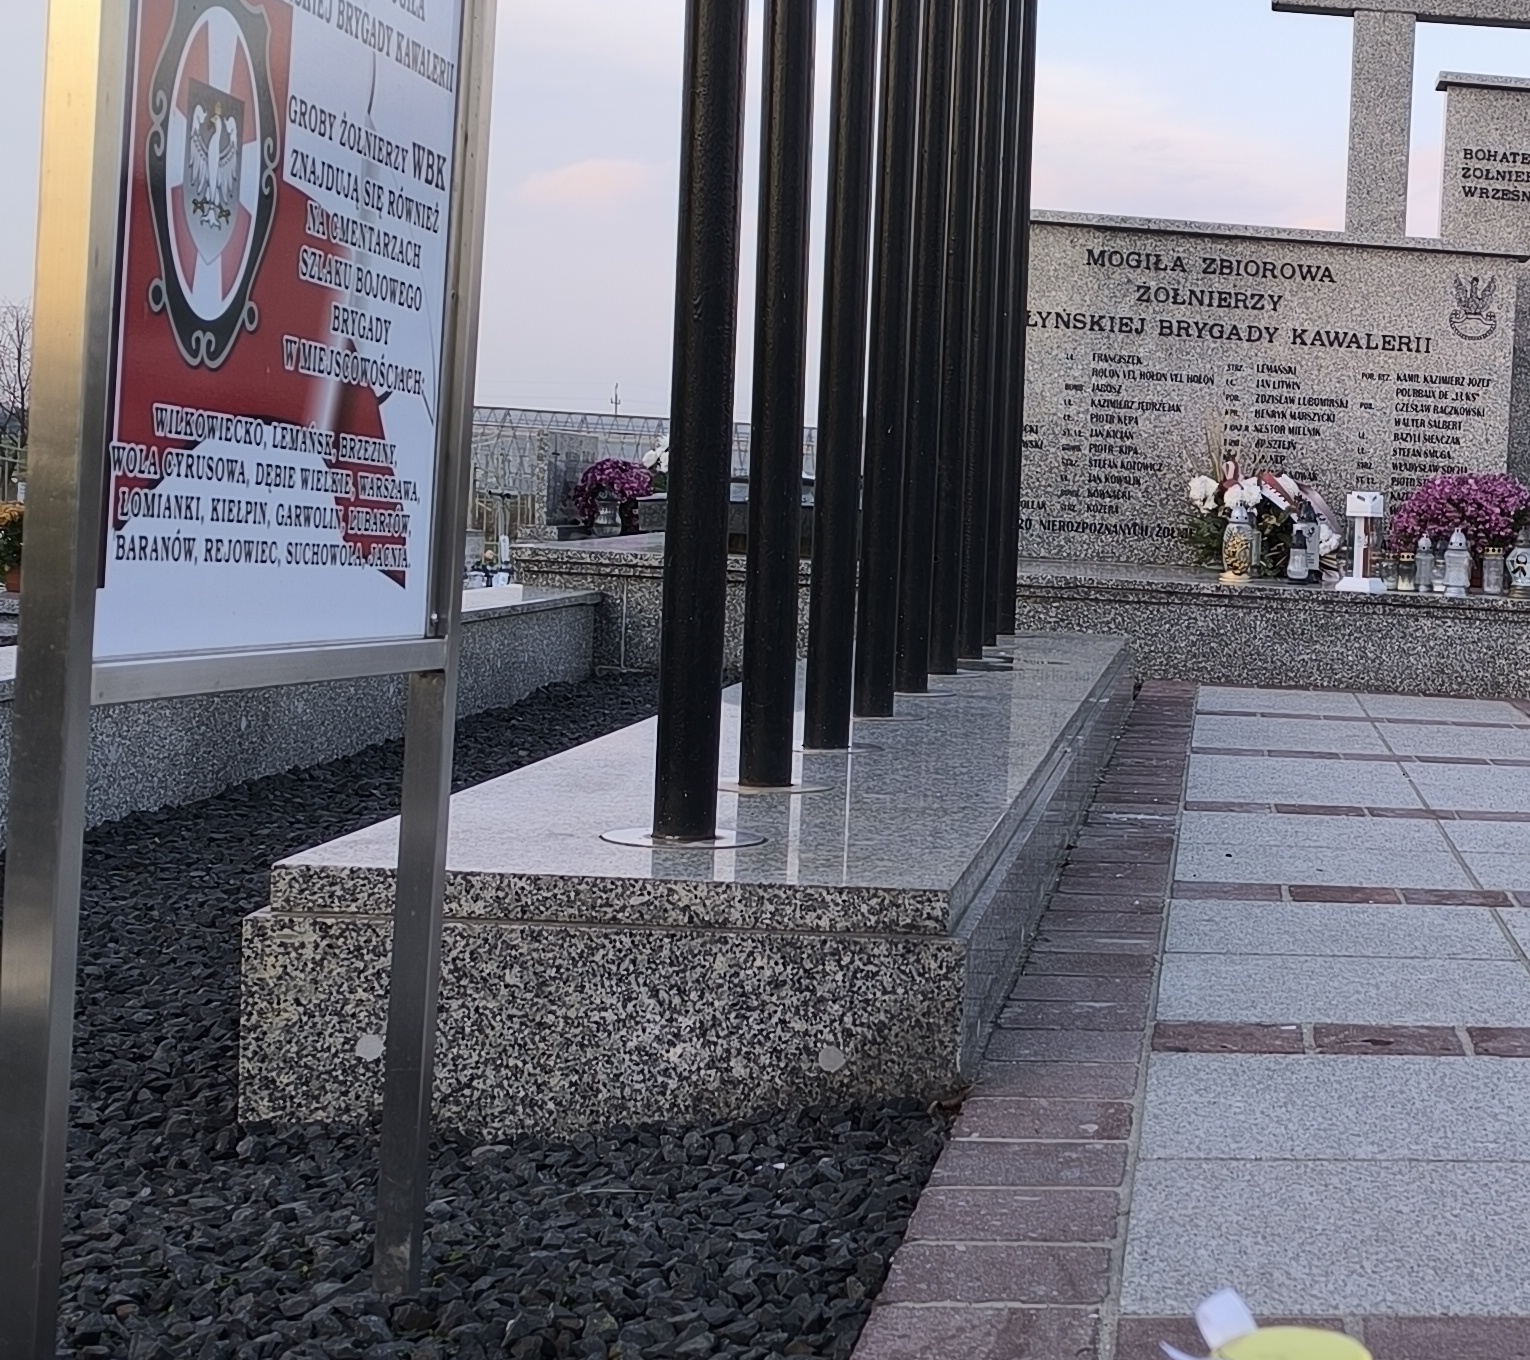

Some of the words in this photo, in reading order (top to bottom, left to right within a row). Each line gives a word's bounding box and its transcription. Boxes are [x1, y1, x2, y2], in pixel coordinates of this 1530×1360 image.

[396, 31, 455, 93] KAWALERII
[288, 94, 336, 141] GROBY
[340, 111, 408, 174] ŻOŁNIERZY
[412, 141, 447, 191] WBK
[290, 148, 359, 210] ZNAJDUJĄ
[363, 179, 385, 219] SIĘ
[387, 186, 440, 234] RÓWNIEŻ
[307, 203, 326, 236] NA
[331, 212, 422, 269] CMENTARZACH
[300, 248, 352, 290] SZLAKU
[355, 267, 423, 312] BOJOWEGO
[1085, 248, 1187, 273] MOGIŁA
[1202, 257, 1337, 283] ZBIOROWA
[1136, 281, 1283, 312] ŻOŁNIERZY
[331, 304, 392, 346] BRYGADY
[1026, 308, 1146, 335] ŁYŃSKIEJ
[1158, 319, 1279, 343] BRYGADY
[1291, 328, 1432, 354] KAWALERII
[284, 338, 297, 367] W
[1423, 374, 1465, 386] KAZIMIERZ
[154, 406, 267, 450] WILKOWIECKO,
[339, 440, 398, 467] BRZEZINY,
[111, 445, 159, 475] WOLA
[164, 450, 250, 488] CYRUSOWA,
[255, 462, 296, 493] DĘBIE
[299, 467, 355, 501] WIELKIE,
[358, 474, 421, 505] WARSZAWA,
[276, 503, 345, 535] GARWOLIN,
[115, 528, 198, 565] BARANÓW,
[203, 538, 281, 568] REJOWIEC,
